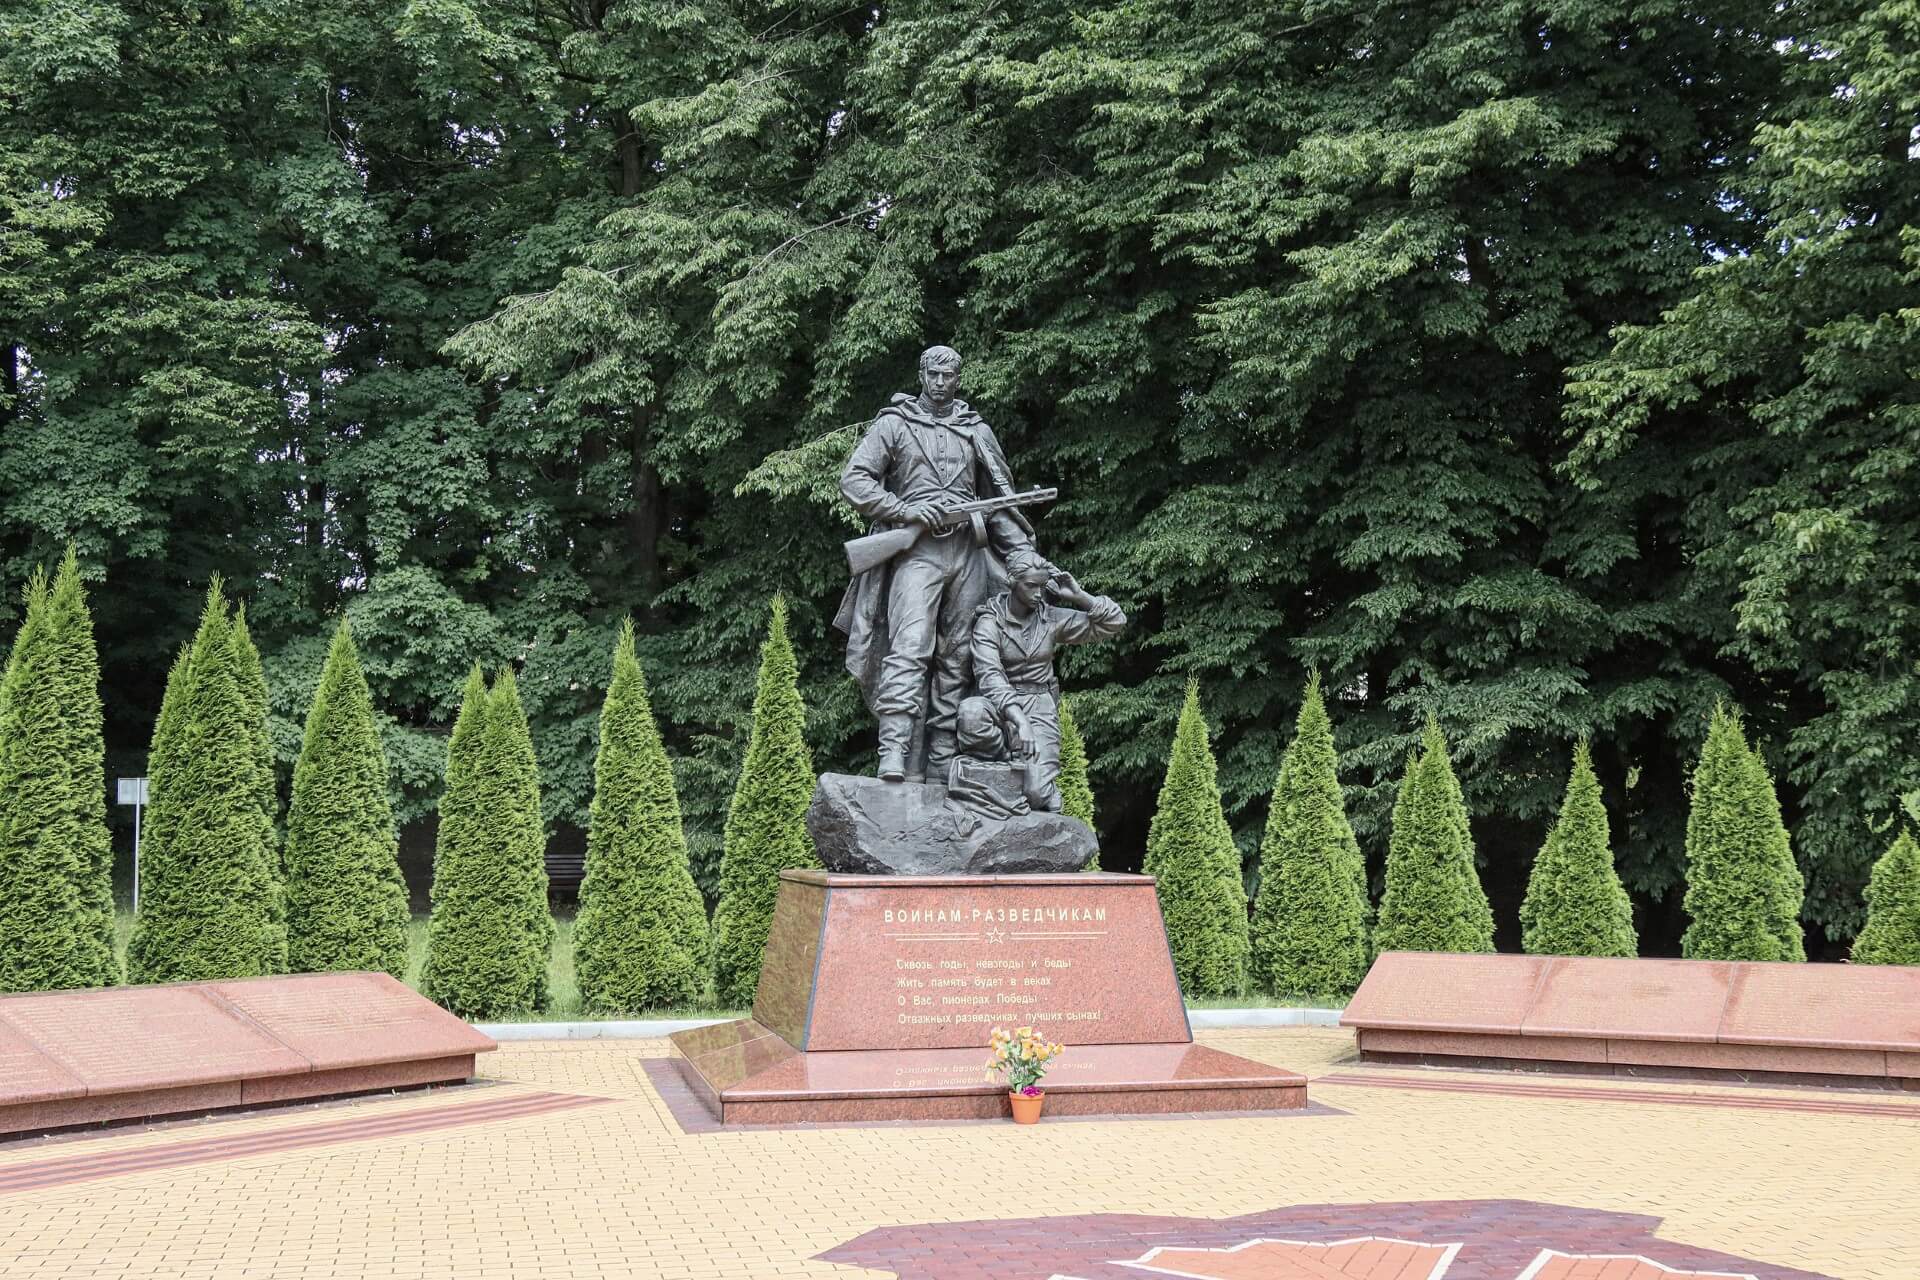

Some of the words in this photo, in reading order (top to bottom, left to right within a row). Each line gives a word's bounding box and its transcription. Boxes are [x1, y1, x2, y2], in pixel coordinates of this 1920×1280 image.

[884, 908, 1107, 923] ВОИНАМ-РАЗВЕДЧИКАМ
[896, 959, 933, 969] Сквозь
[976, 960, 1024, 969] невзгоды
[1031, 960, 1037, 968] и
[1044, 958, 1071, 968] беды
[896, 977, 923, 988] Жить
[931, 978, 967, 987] память
[974, 976, 1003, 987] будет
[1010, 978, 1016, 986] в
[1024, 977, 1051, 986] веках
[897, 995, 906, 1006] О
[913, 995, 935, 1006] Вас,
[942, 996, 990, 1005] пионерах
[996, 993, 1038, 1005] Победы
[898, 1013, 951, 1024] Отважных
[955, 1014, 1018, 1025] разведчиках
[1025, 1013, 1063, 1023] лучших
[1066, 1010, 1101, 1021] сынах!
